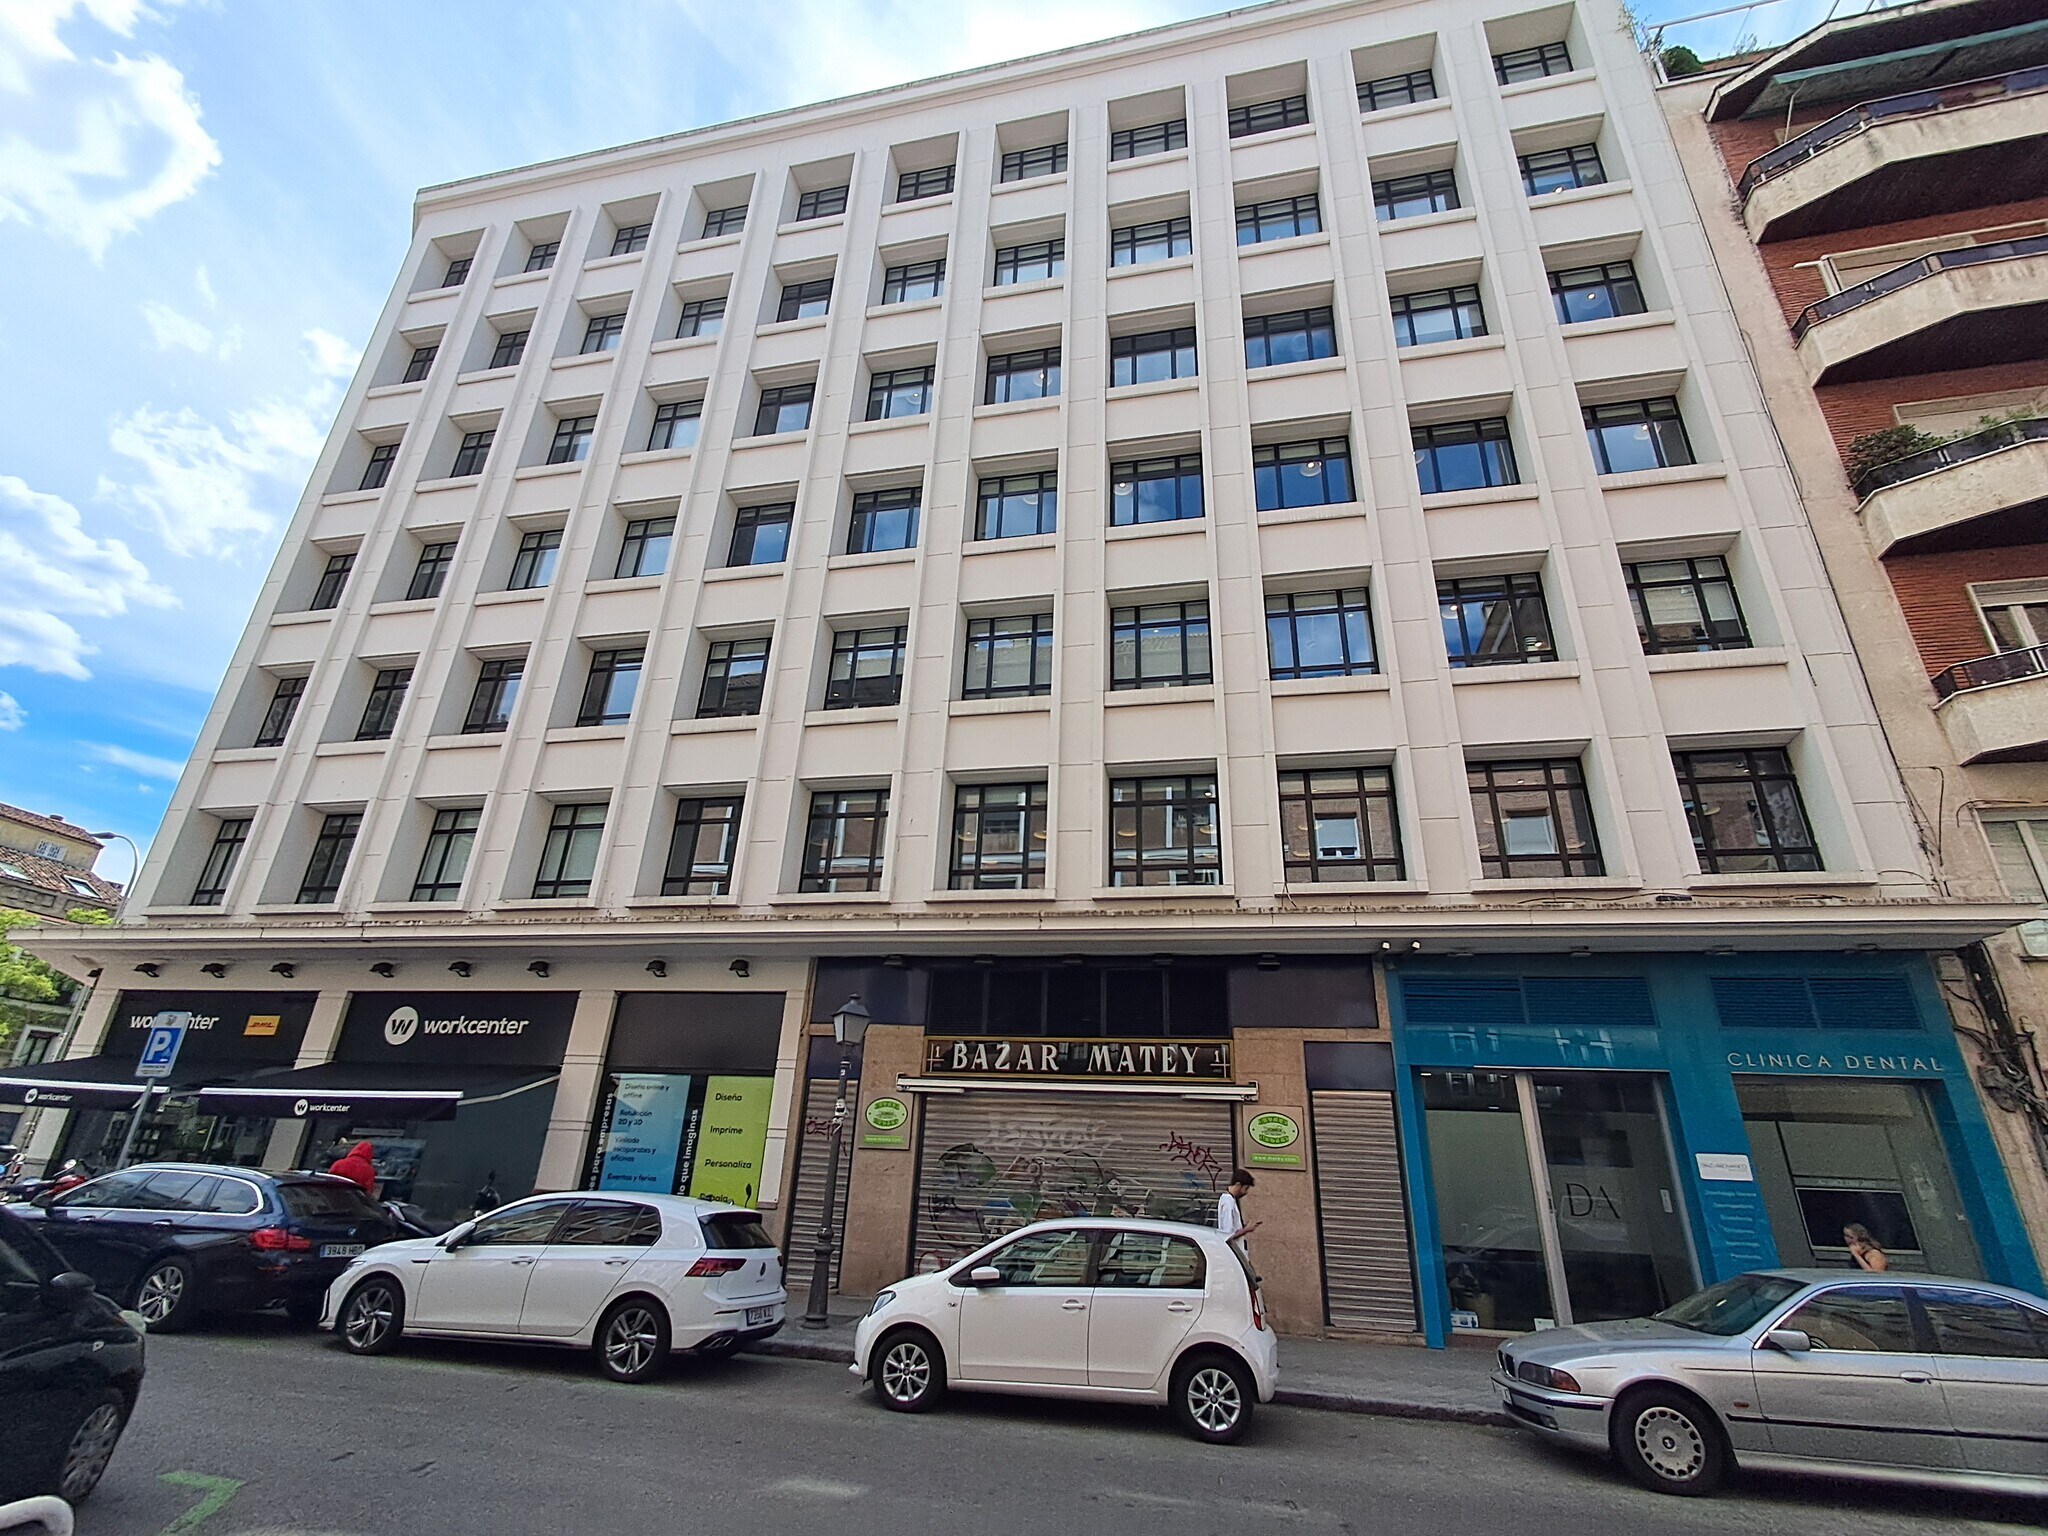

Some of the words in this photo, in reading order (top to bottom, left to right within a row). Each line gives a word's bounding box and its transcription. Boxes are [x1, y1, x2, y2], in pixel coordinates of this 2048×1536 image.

[424, 1016, 530, 1035] workcenter
[145, 1030, 173, 1061] P
[951, 1042, 1060, 1072] BAZAR
[1087, 1044, 1199, 1074] MATEY
[1727, 1052, 1832, 1069] CLINICA
[1844, 1055, 1945, 1072] DENTAL
[309, 1102, 351, 1112] workcenter
[715, 1093, 743, 1102] Diseña
[598, 1092, 614, 1146] empresas
[683, 1109, 699, 1160] imaginas
[710, 1125, 744, 1136] Imprime
[680, 1162, 691, 1183] que
[704, 1159, 753, 1169] Personaliza
